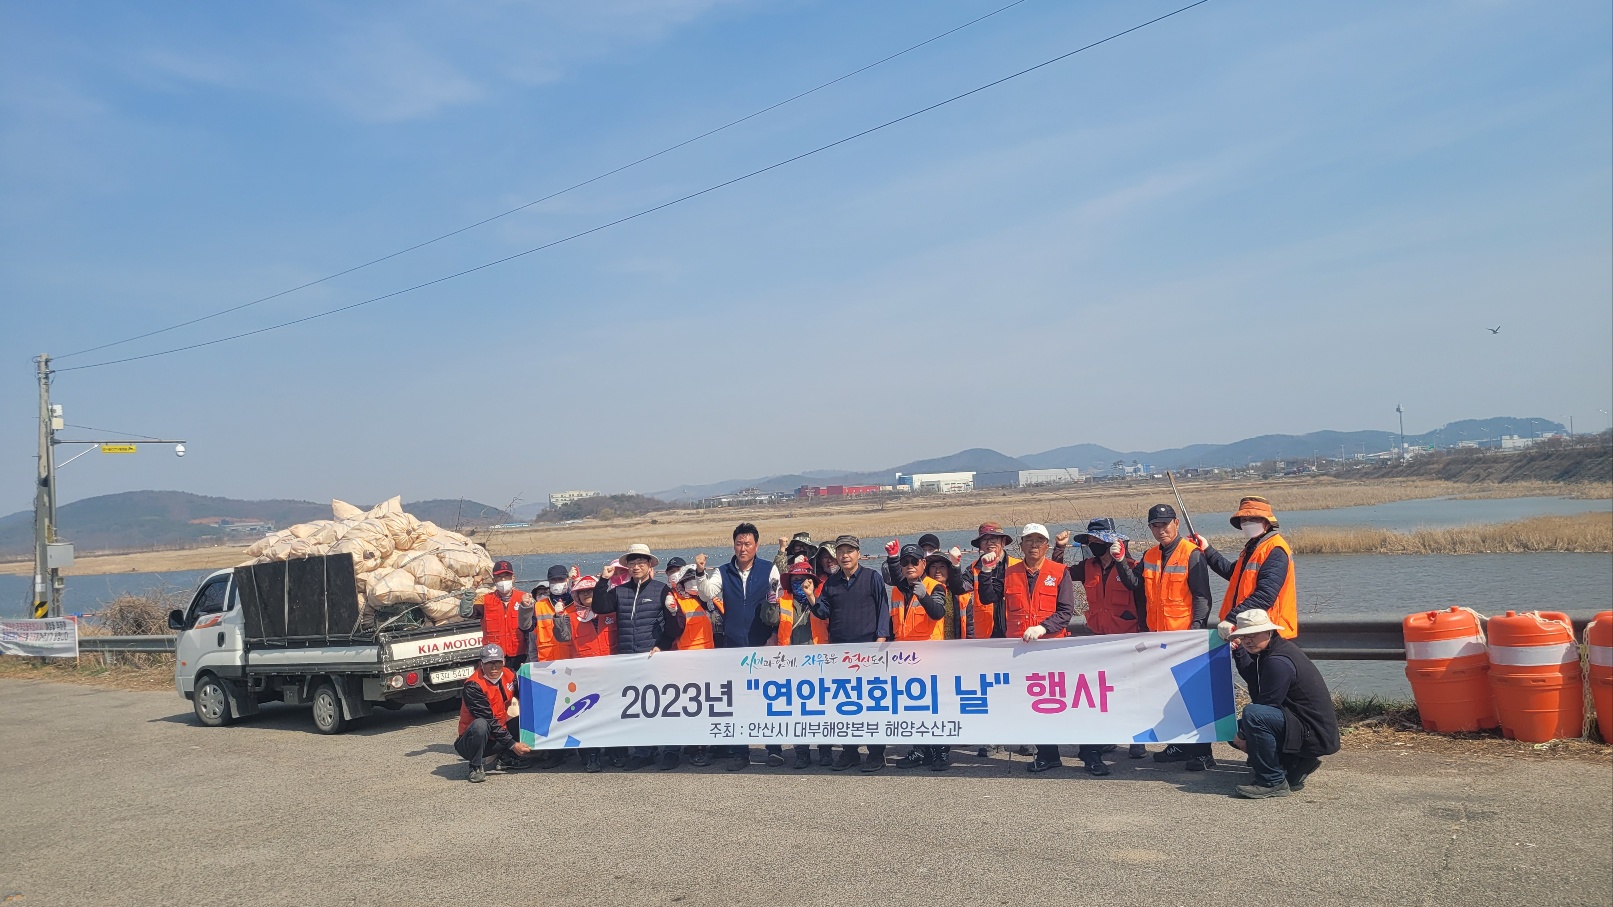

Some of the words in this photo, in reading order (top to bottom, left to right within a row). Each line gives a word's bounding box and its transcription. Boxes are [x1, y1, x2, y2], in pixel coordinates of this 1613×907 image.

[418, 643, 440, 654] KIA
[801, 653, 839, 675] 자유로운
[891, 651, 922, 665] 안산
[620, 678, 734, 720] 2023년
[746, 675, 940, 717] "연안정화의
[953, 672, 1011, 715] 날"
[1025, 670, 1115, 715] 행사
[709, 721, 736, 739] 주최
[748, 720, 789, 738] 안산시
[793, 719, 880, 738] 대부해양본부
[884, 718, 963, 738] 해양수산과
